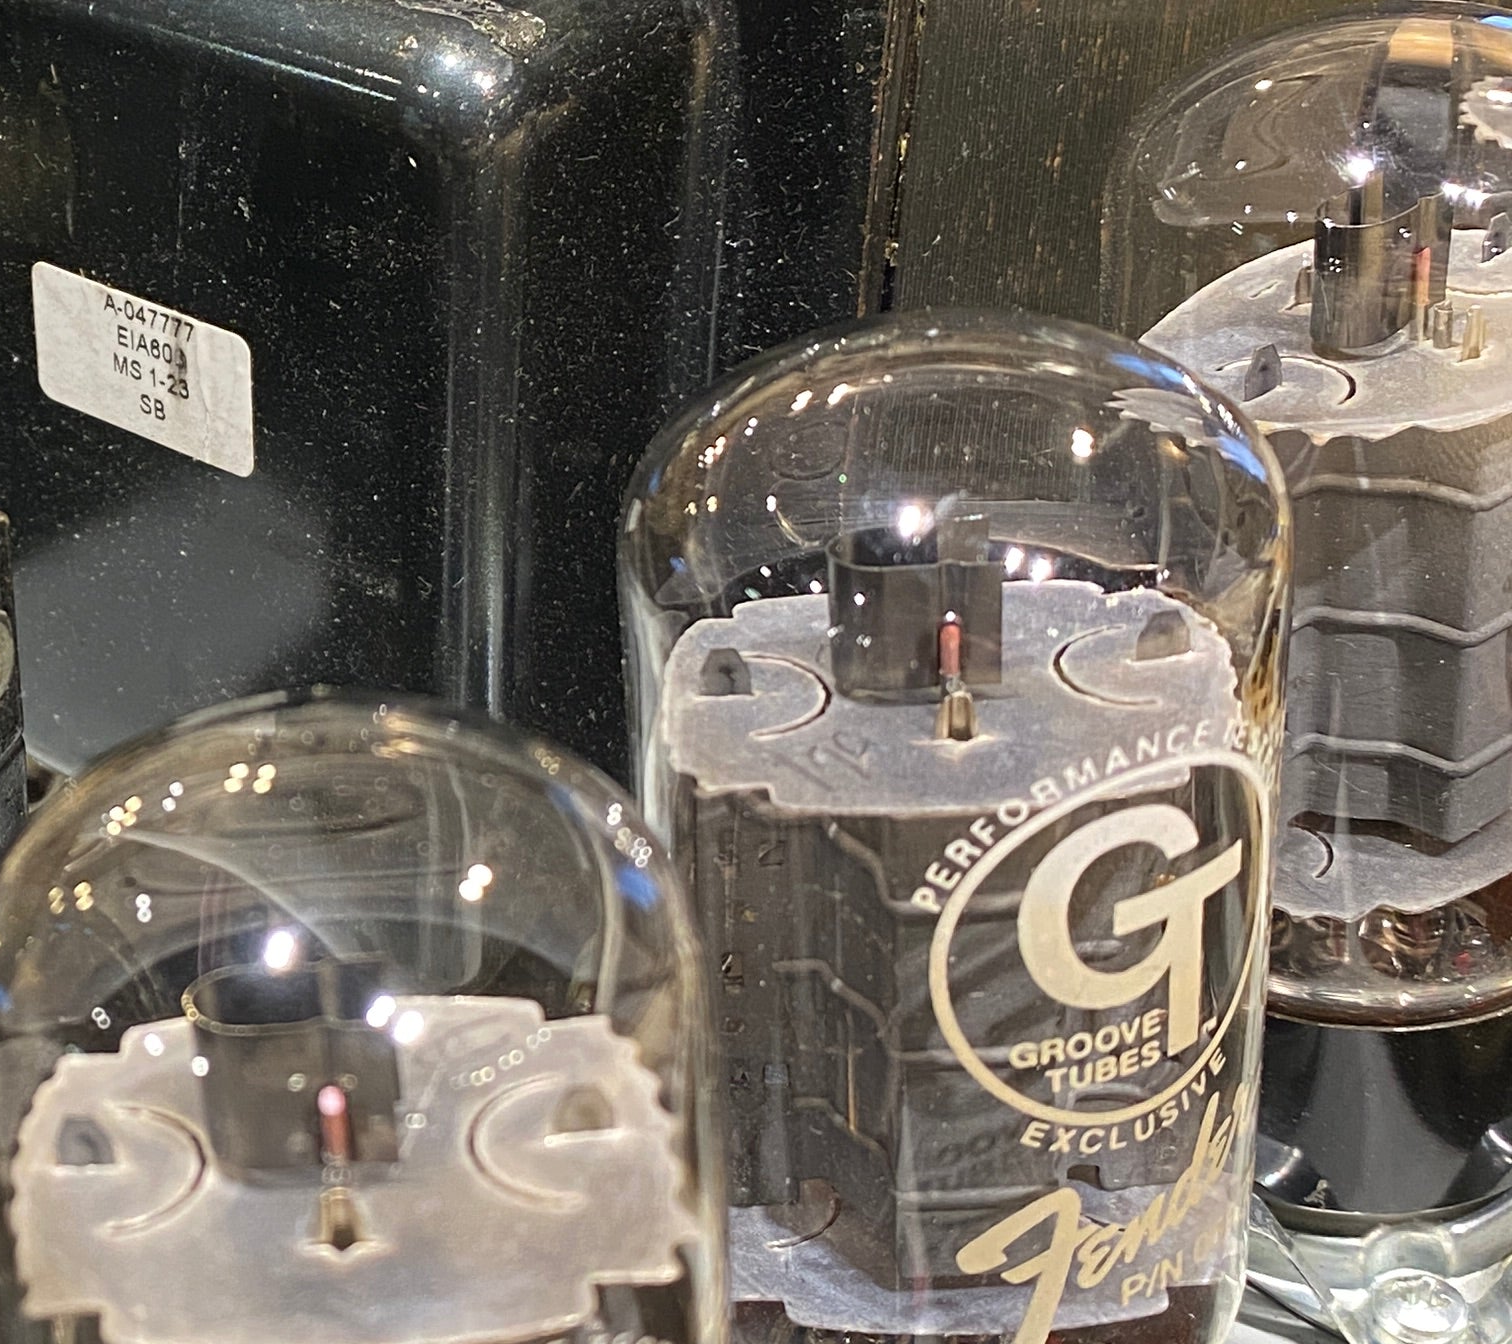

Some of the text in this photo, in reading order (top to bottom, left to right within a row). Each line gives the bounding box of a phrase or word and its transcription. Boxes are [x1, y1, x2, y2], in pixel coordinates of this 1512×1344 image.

[104, 294, 194, 343] A-047777
[113, 352, 190, 400] MS 1-23
[139, 393, 166, 422] SB
[910, 720, 1210, 914] PERFORMANCE
[1018, 803, 1243, 1056] GT
[1008, 1007, 1166, 1070] GROOVE
[1044, 1039, 1163, 1094] TUBES
[1019, 1046, 1227, 1155] EXCLUSIVE
[1120, 1250, 1185, 1308] P/N
